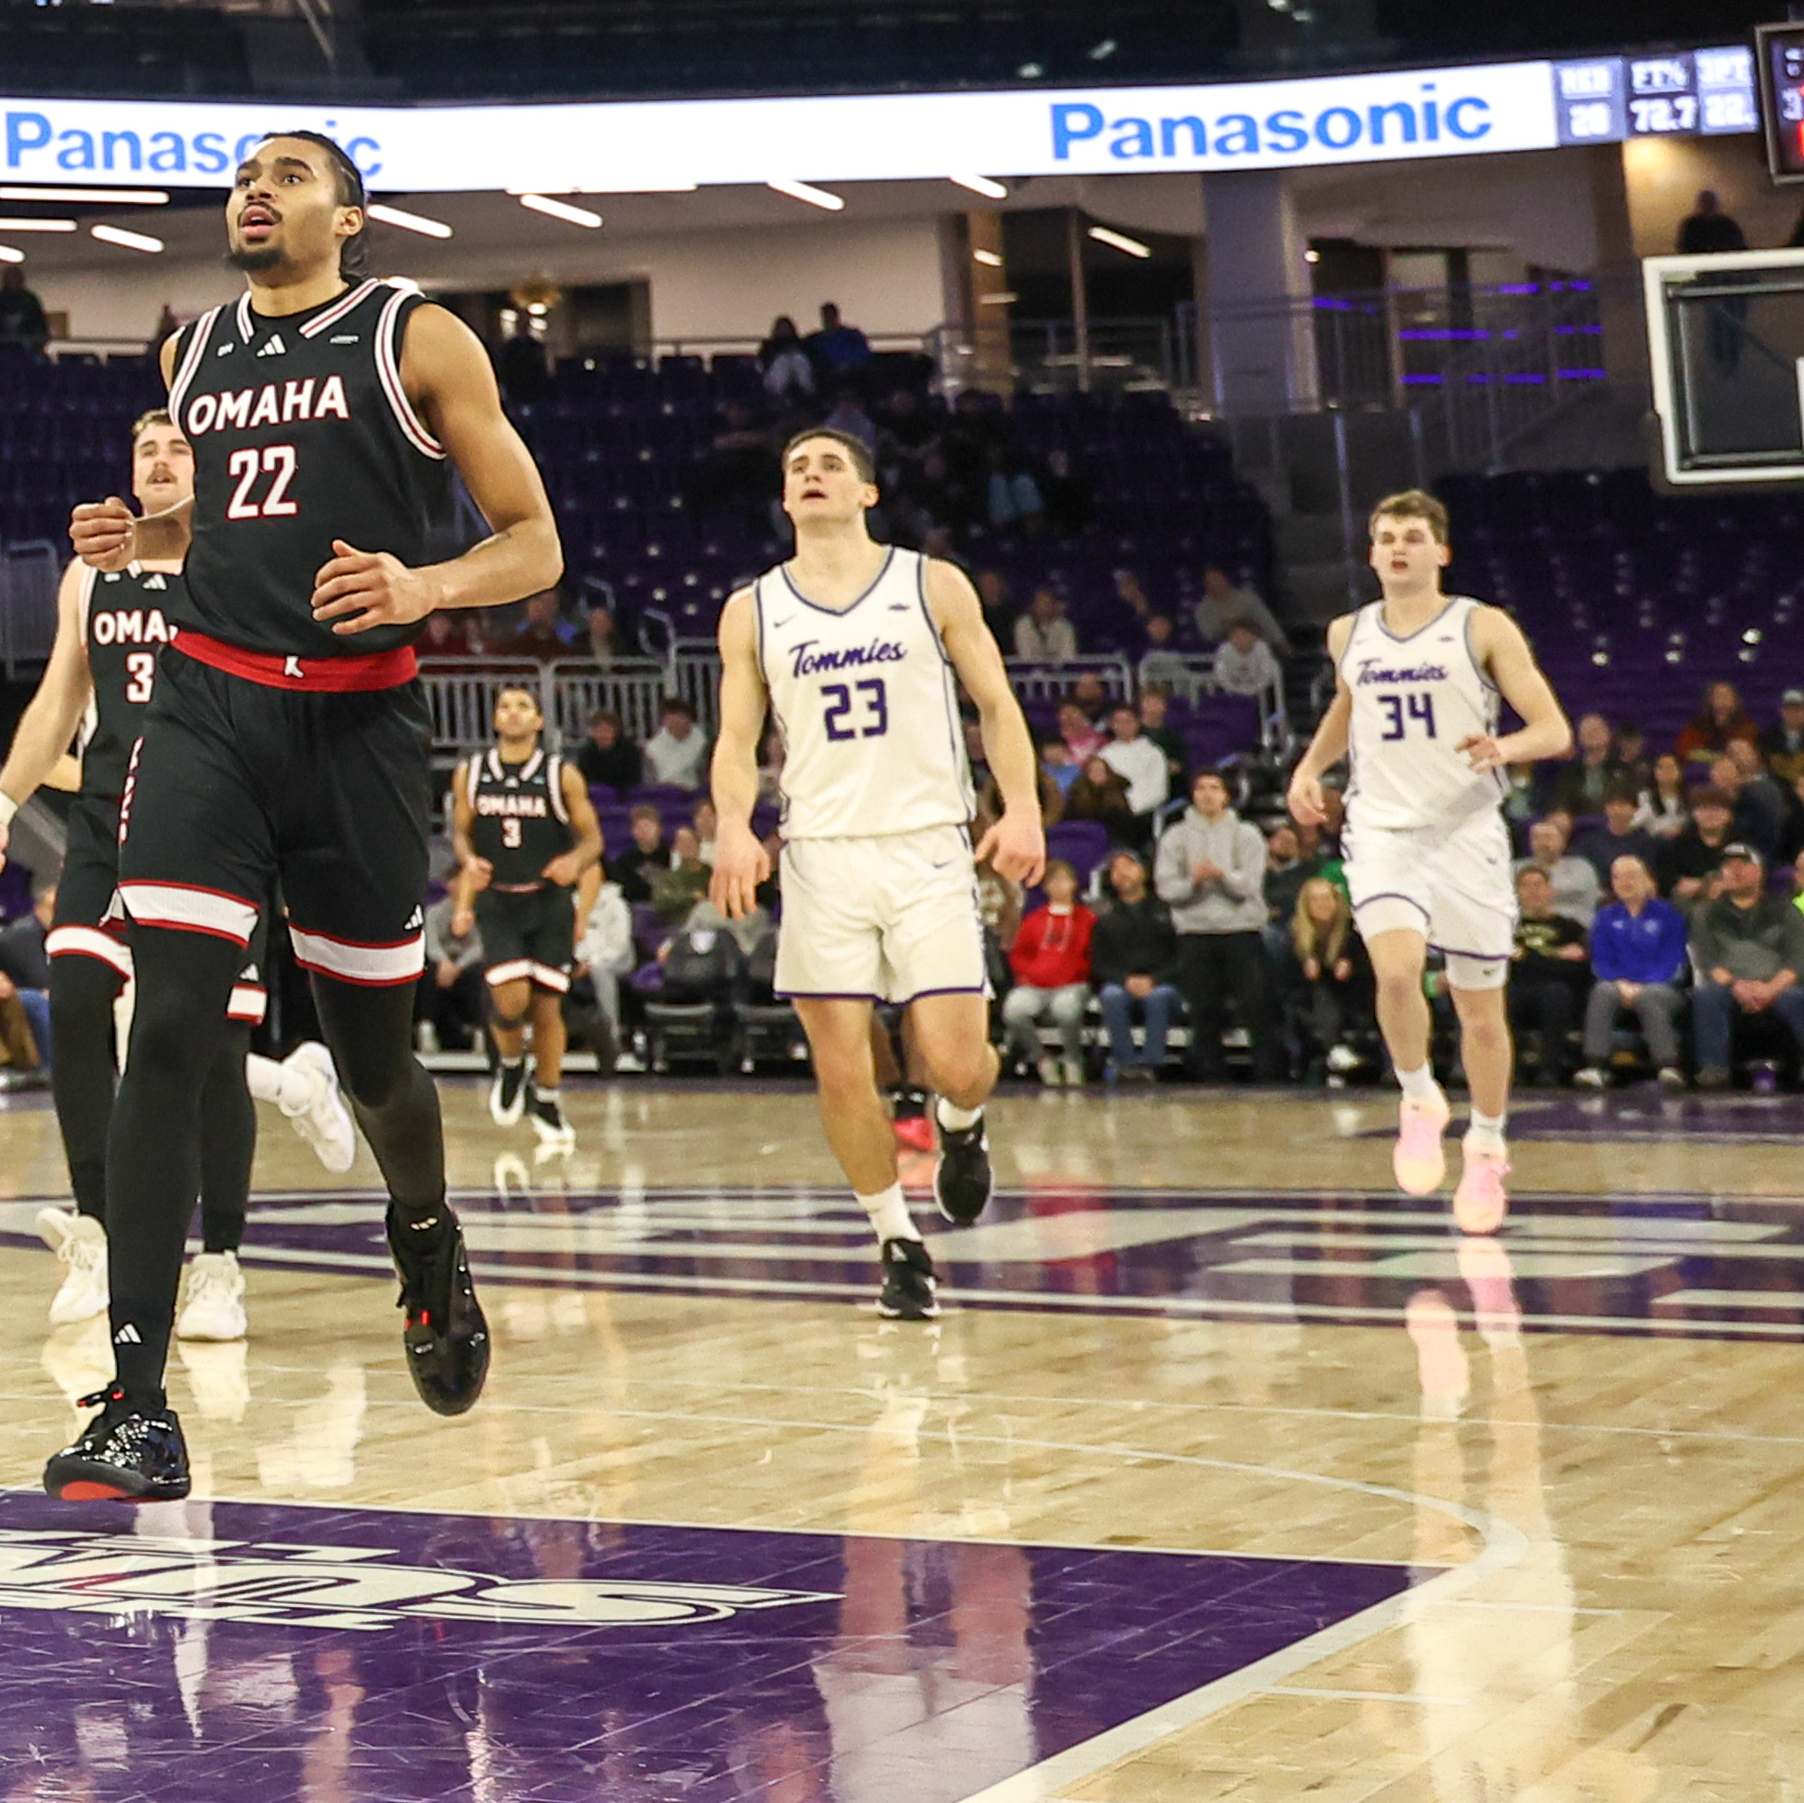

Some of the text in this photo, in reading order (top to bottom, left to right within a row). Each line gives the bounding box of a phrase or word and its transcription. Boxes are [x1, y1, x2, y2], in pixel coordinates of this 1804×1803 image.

[4, 110, 384, 180] Panasc
[1049, 82, 1492, 162] Panasonic
[188, 374, 350, 437] OMAHA
[226, 444, 299, 519] 22
[93, 609, 179, 646] OMA
[125, 650, 156, 703] 3
[788, 637, 908, 678] Tommies
[1356, 659, 1450, 688] Tommies
[820, 677, 889, 742] 23
[1376, 693, 1437, 742] 34
[476, 793, 547, 818] OMAHA
[502, 817, 522, 848] 3
